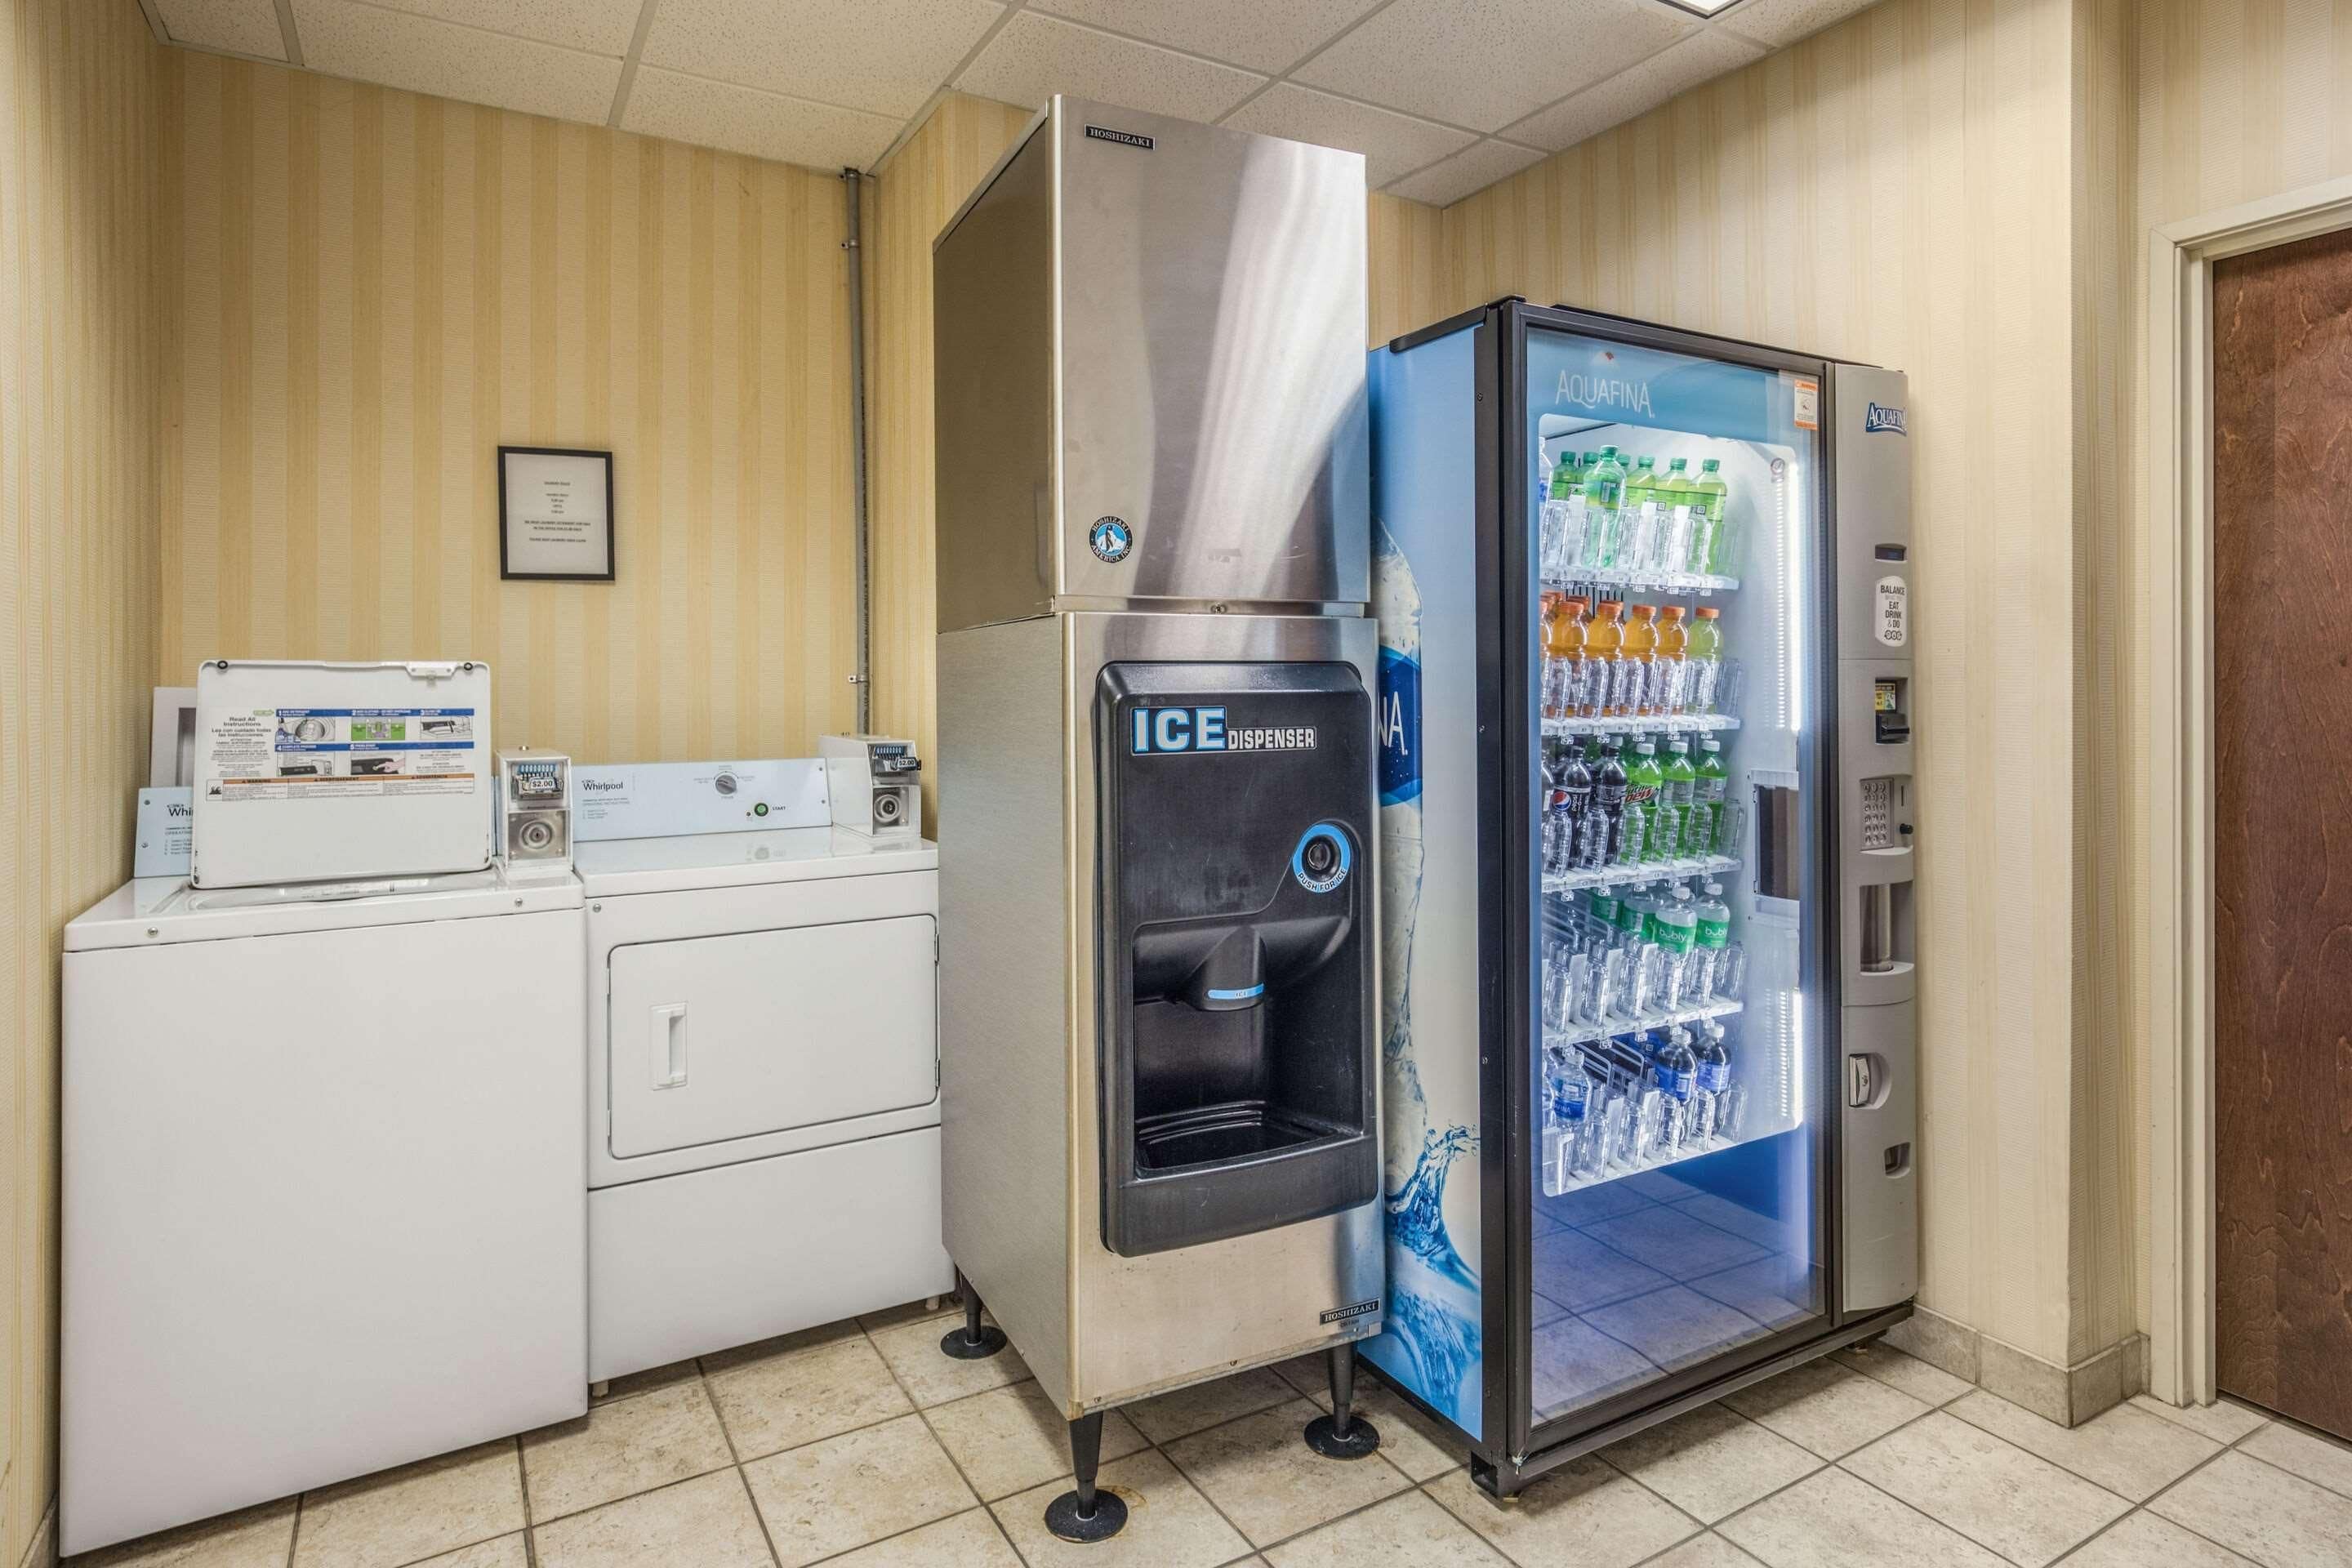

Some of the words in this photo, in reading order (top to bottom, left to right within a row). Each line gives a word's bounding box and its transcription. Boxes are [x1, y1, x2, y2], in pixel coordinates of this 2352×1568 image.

[1089, 127, 1151, 147] HOSHIZAKI
[1555, 369, 1653, 418] AQUAFINA
[1880, 586, 1905, 595] BALANCE
[1889, 601, 1900, 609] EAT
[1885, 610, 1902, 619] DRINK
[1892, 620, 1900, 628] DO
[1134, 708, 1225, 752] ICE
[1227, 728, 1315, 750] DISPENSER
[583, 782, 624, 792] Whirlpool
[1298, 872, 1317, 890] PUSH
[1320, 881, 1334, 890] FOR
[1337, 868, 1347, 881] ICE
[1325, 1303, 1376, 1321] HOSHIZAKI
